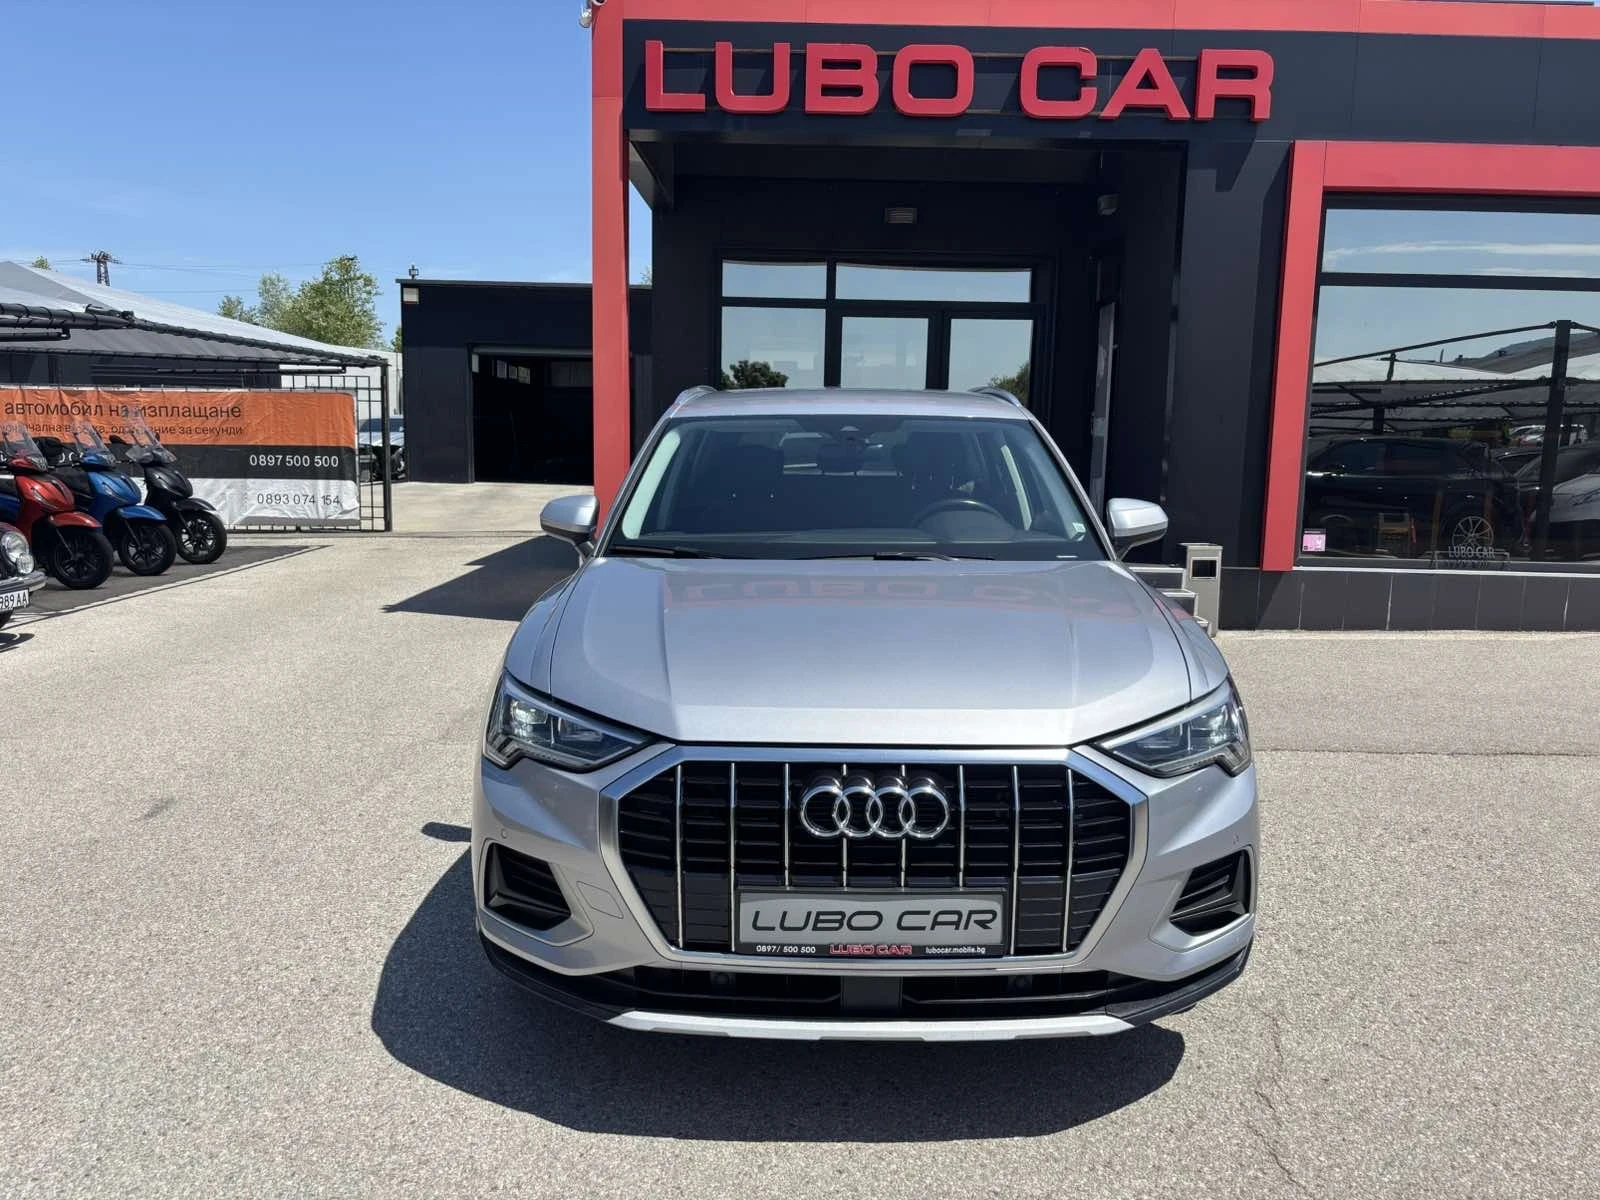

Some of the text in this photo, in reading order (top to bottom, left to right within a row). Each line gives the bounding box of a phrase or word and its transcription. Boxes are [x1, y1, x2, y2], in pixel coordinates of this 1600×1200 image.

[645, 40, 1275, 121] LUBO CAR
[5, 400, 103, 416] автомобил
[110, 404, 129, 417] на
[178, 425, 192, 434] за
[195, 425, 243, 436] секунди
[249, 454, 339, 467] 0897 500 500
[257, 493, 341, 506] 0893 074 154
[752, 909, 998, 931] LUBO CAR
[783, 945, 799, 954] 500
[800, 946, 816, 954] 500
[829, 944, 913, 956] LUBO CAR
[925, 945, 986, 955] lubocar.mobile.bg
